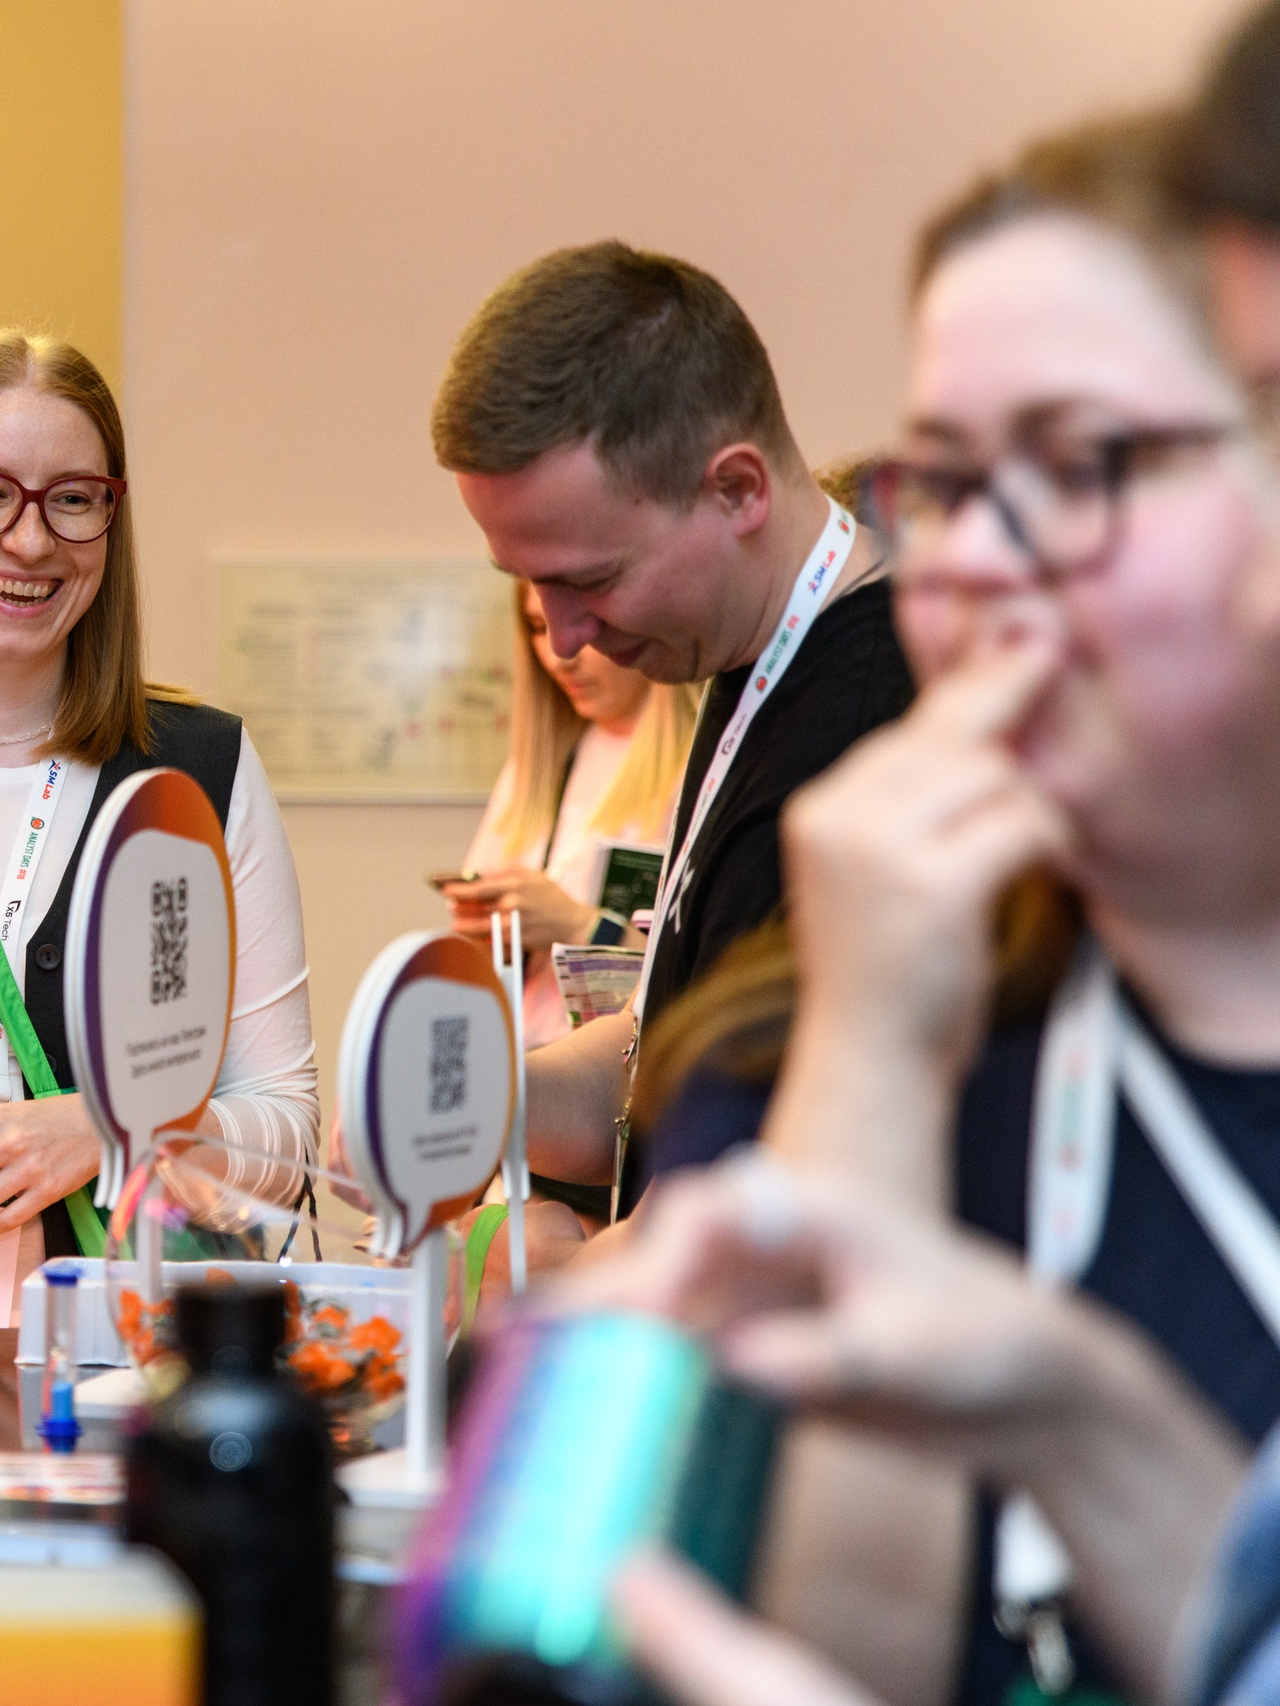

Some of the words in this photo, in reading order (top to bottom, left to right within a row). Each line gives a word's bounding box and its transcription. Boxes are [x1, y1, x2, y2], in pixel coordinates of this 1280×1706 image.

[47, 769, 58, 786] SM
[42, 783, 54, 800] Lab
[24, 831, 39, 855] ANALYST
[20, 854, 32, 868] DAYS
[16, 868, 27, 880] #18
[1, 919, 12, 942] Tech
